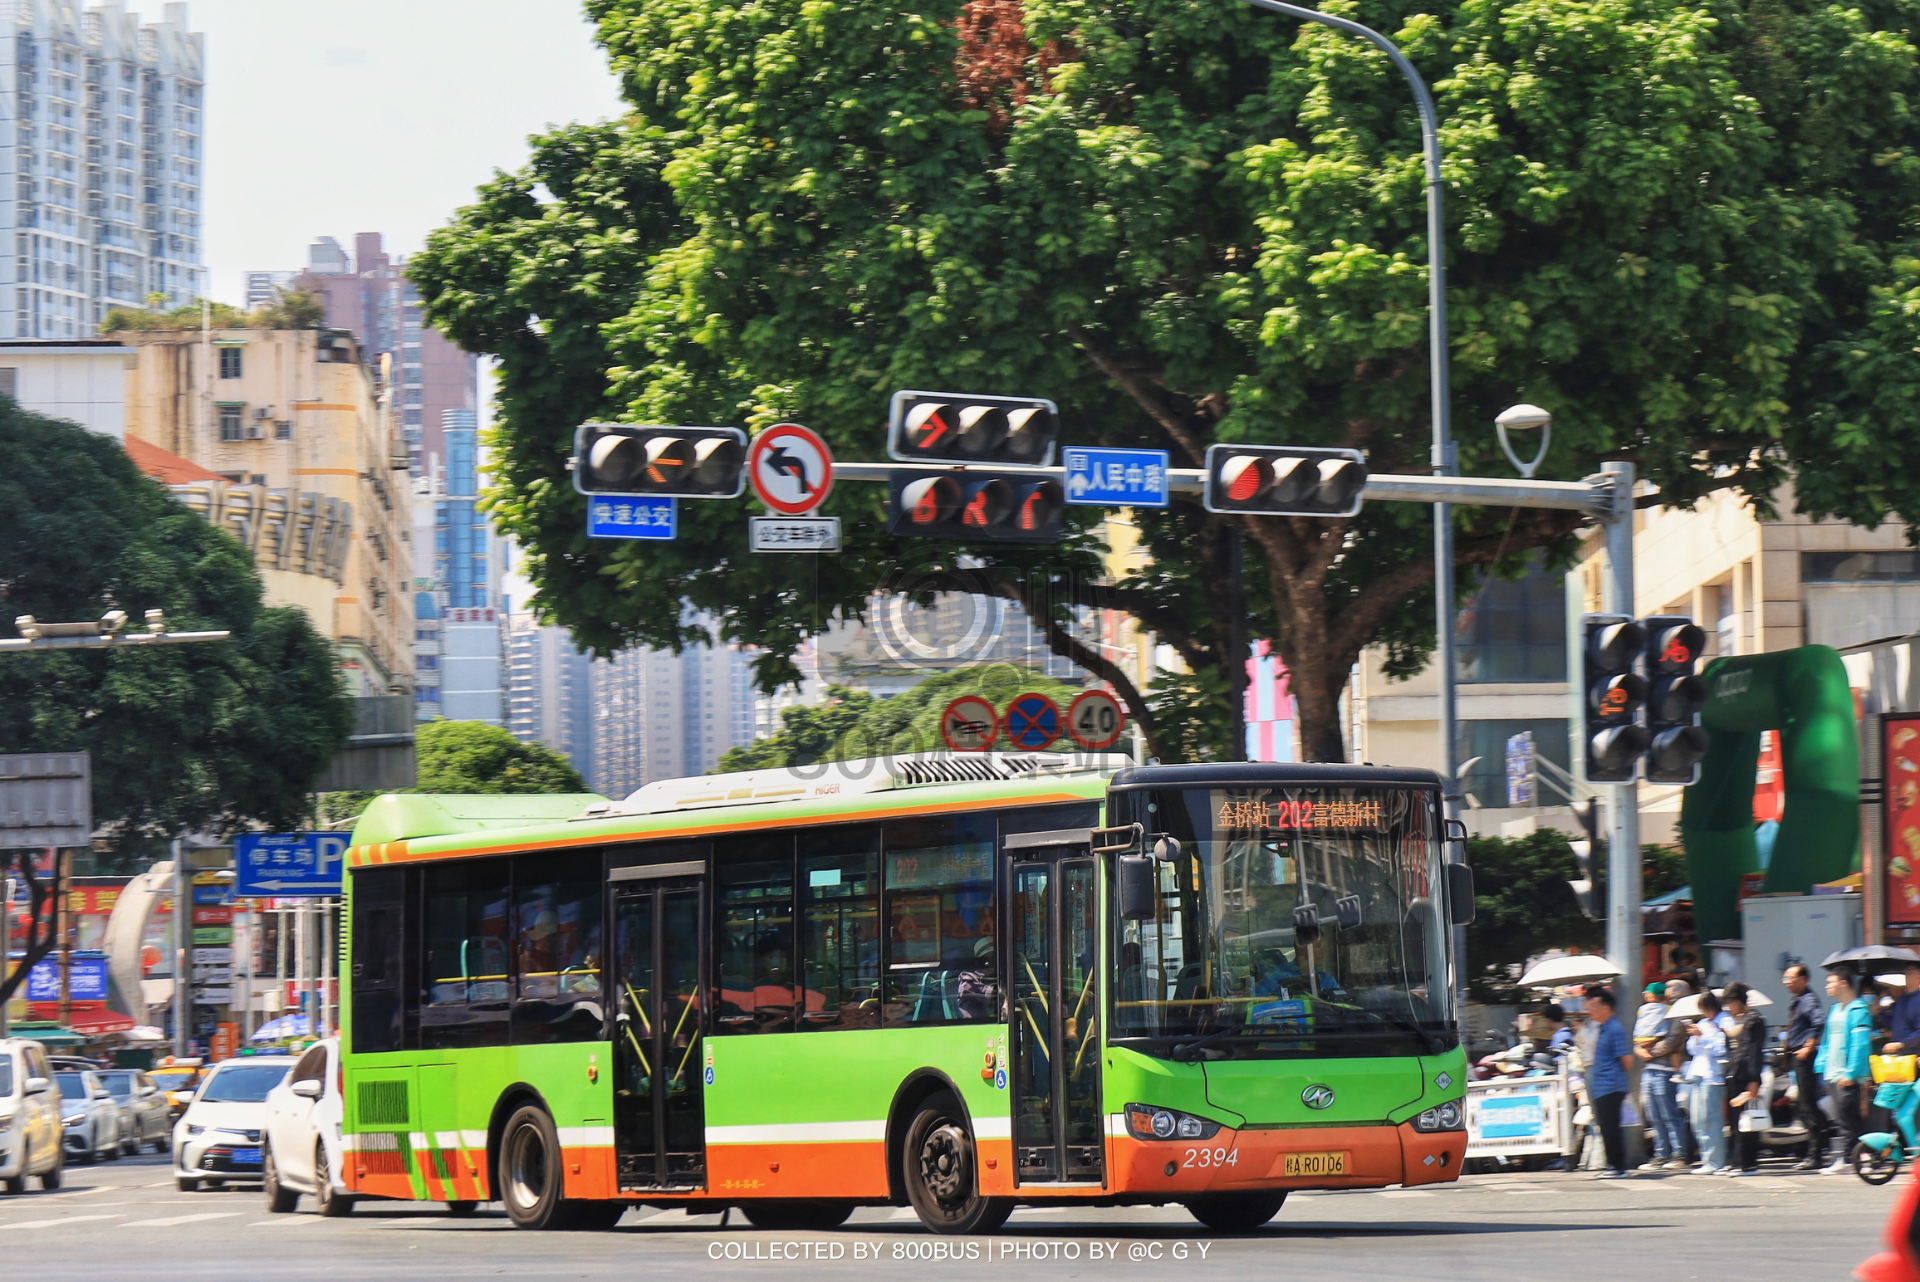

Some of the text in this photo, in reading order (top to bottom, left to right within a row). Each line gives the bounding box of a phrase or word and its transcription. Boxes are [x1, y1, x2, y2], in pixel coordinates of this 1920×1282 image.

[1086, 462, 1163, 492] 人民中路
[593, 503, 671, 526] 快速公交
[1078, 705, 1115, 734] 40
[815, 783, 841, 795] HIGER
[1217, 801, 1381, 828] 金桥站 202 富德新村
[248, 848, 314, 865] 停车场
[316, 837, 346, 875] P
[896, 857, 918, 884] 202
[1182, 1147, 1239, 1168] 2394
